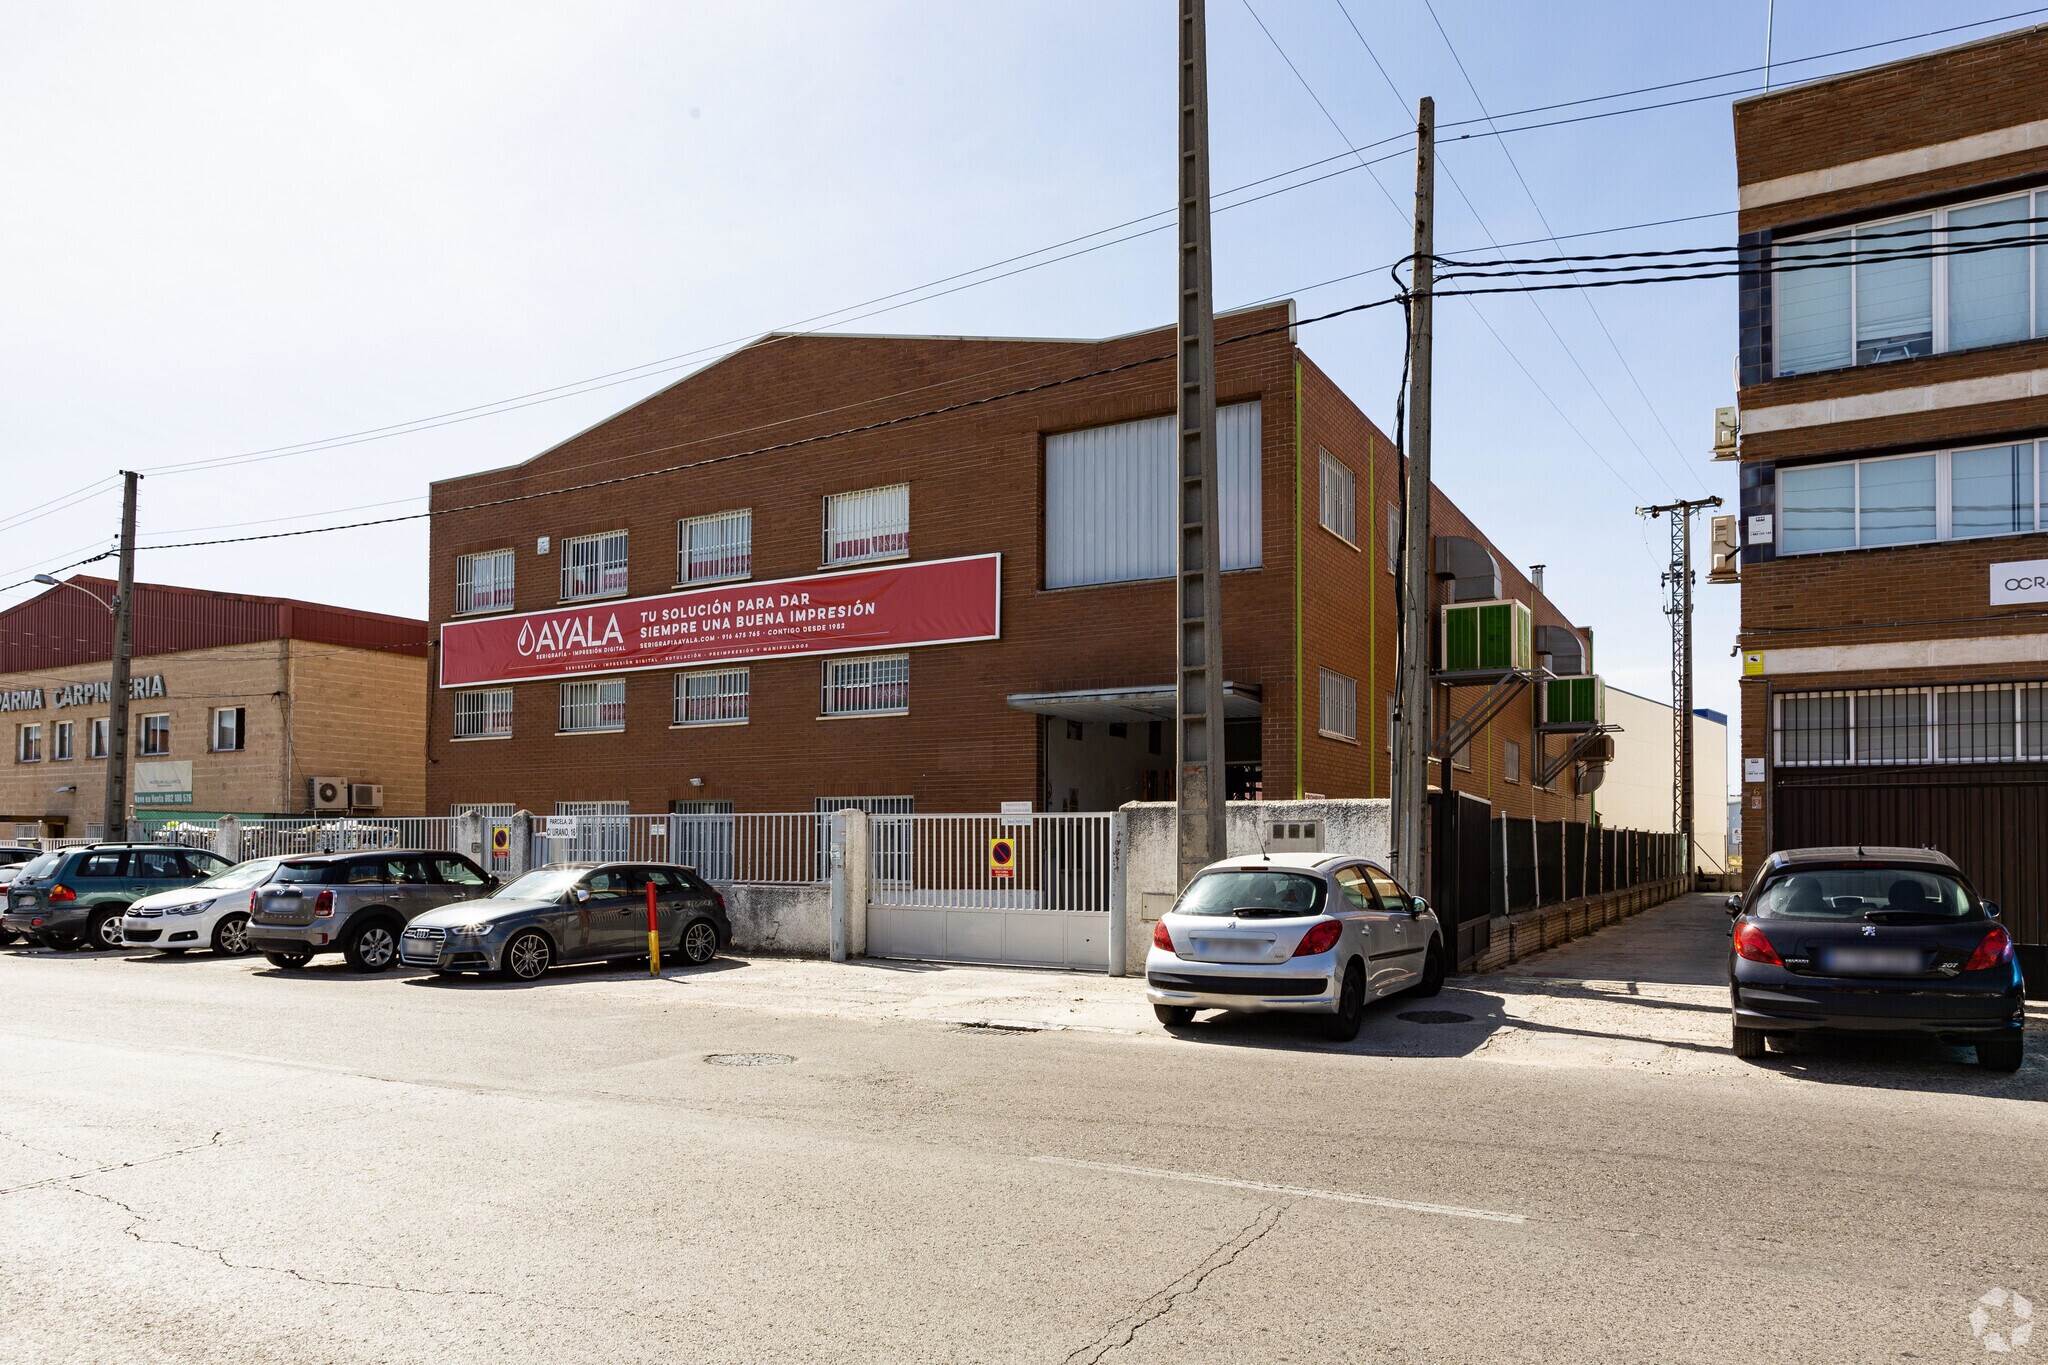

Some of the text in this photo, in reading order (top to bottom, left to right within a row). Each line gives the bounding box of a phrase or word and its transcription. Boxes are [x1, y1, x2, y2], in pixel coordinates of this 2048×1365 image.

[2005, 577, 2048, 591] OCR
[640, 592, 810, 623] TU SOLUCIÓN PARA DAR
[640, 599, 875, 638] SIEMPRE UNA BUENA IMPRESIÓN
[535, 612, 624, 653] AYALA
[640, 635, 715, 649] SERIGRAFIAAYALA.COM
[767, 626, 801, 636] CONTIGO
[803, 624, 826, 633] DESDE
[829, 622, 845, 630] 1982
[536, 645, 626, 660] SERIGRAFÍA IMPRESIÓN DIGITAL
[0, 674, 165, 711] ARMA CARPINRIA
